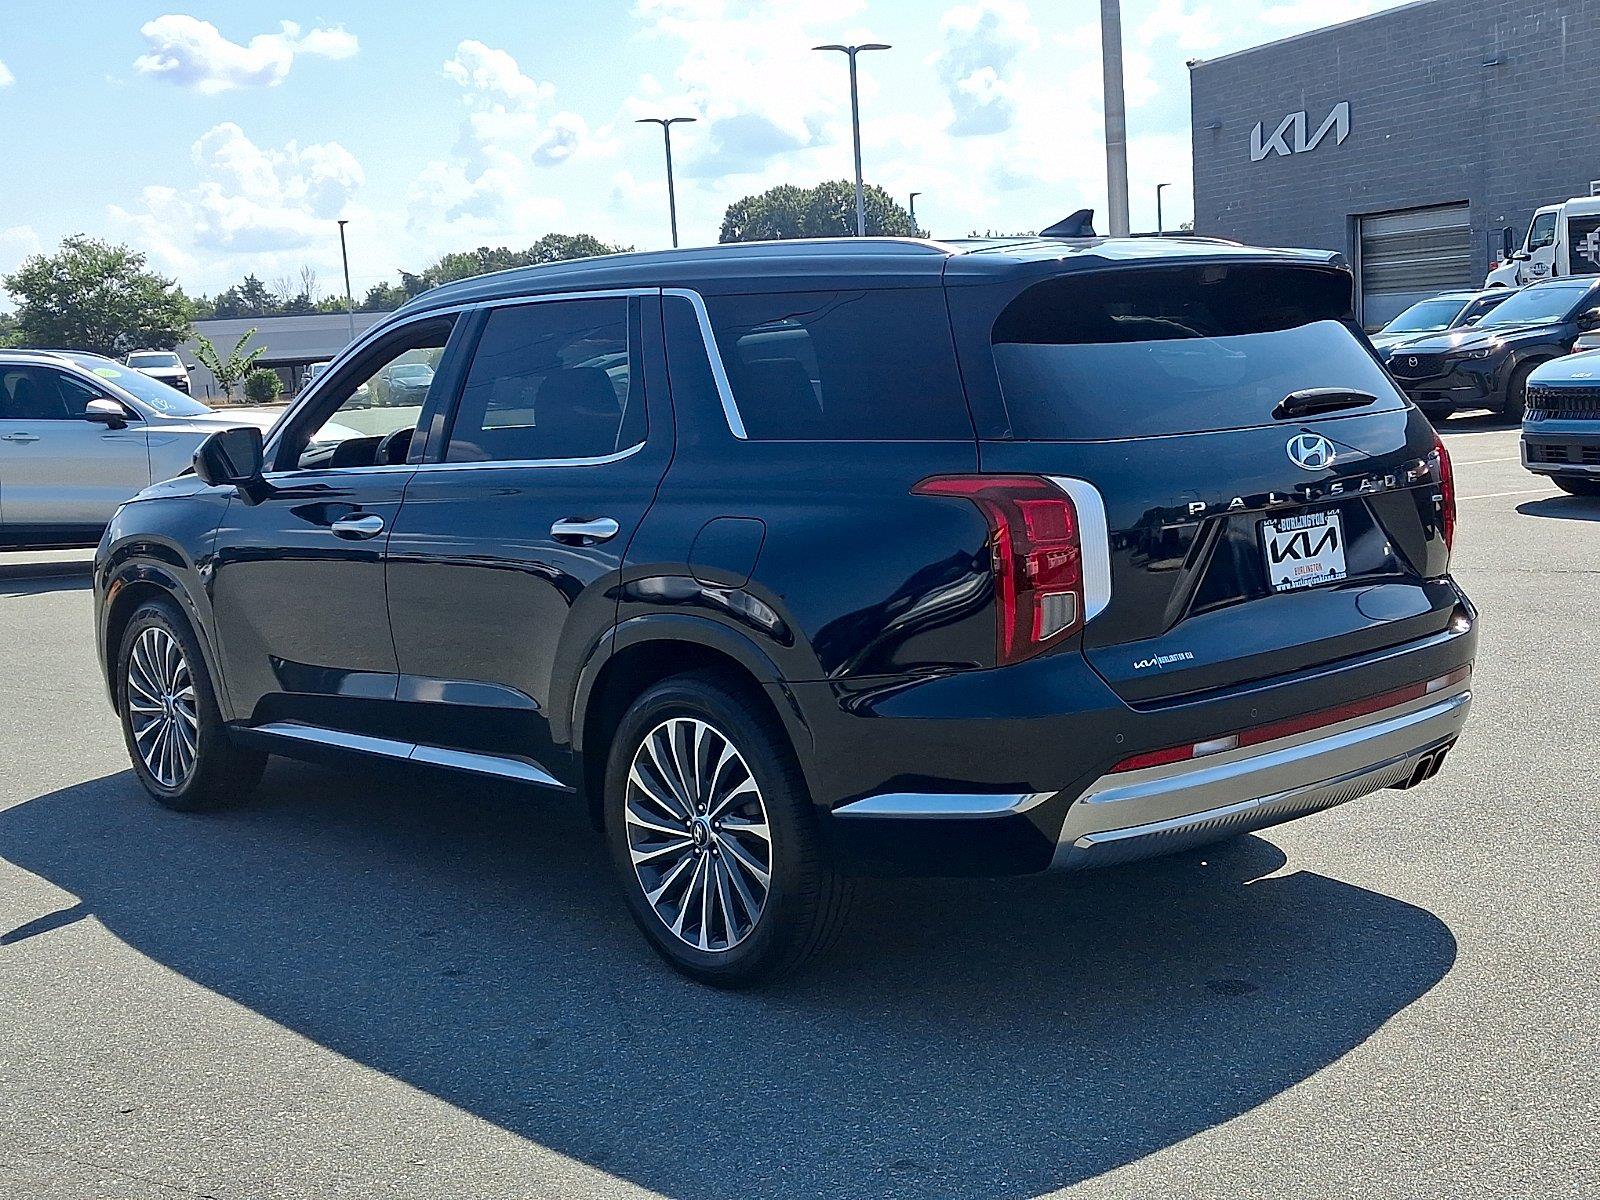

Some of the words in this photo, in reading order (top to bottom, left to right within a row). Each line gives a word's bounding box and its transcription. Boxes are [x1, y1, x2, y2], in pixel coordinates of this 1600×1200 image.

[1251, 101, 1349, 161] KIA
[1188, 470, 1418, 515] PALISADE
[1280, 512, 1326, 531] BURLINGTON
[1269, 526, 1339, 563] KIA
[1294, 563, 1323, 576] BURLINGTON
